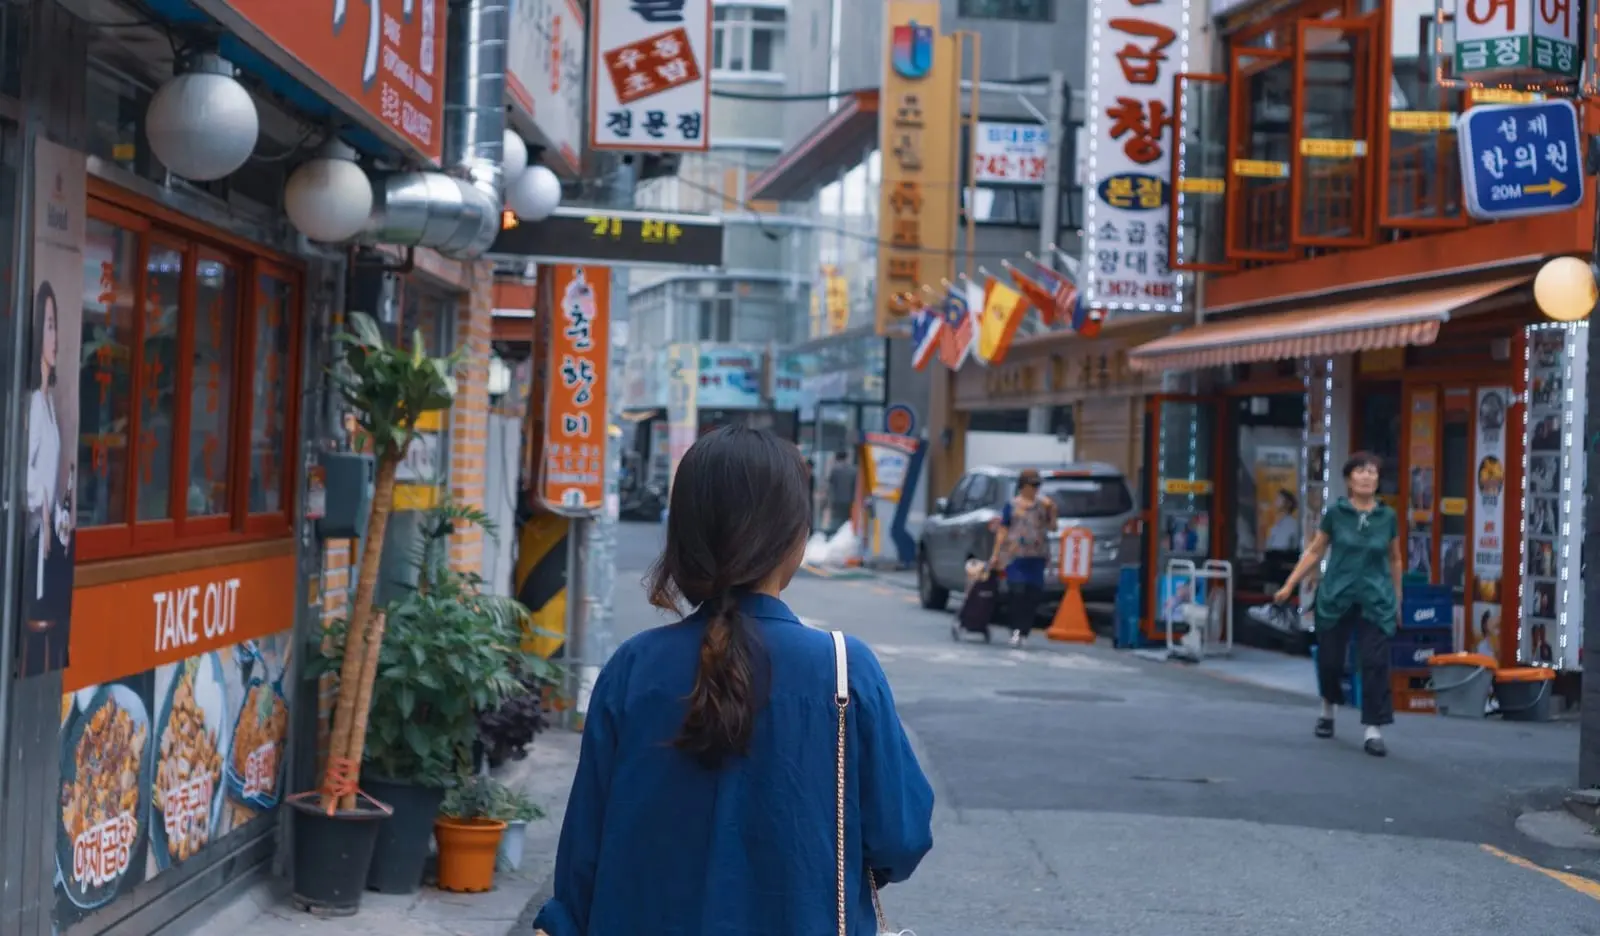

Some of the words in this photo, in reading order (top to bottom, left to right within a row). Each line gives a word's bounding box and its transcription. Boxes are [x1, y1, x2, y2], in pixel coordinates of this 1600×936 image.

[1462, 37, 1521, 69] 금정
[1536, 38, 1573, 71] 금정
[606, 109, 701, 139] 전문점
[1481, 140, 1569, 179] 한의원
[1105, 177, 1163, 208] 본점
[1491, 183, 1522, 200] 20M
[153, 584, 200, 652] TAKE
[204, 578, 240, 639] OUT
